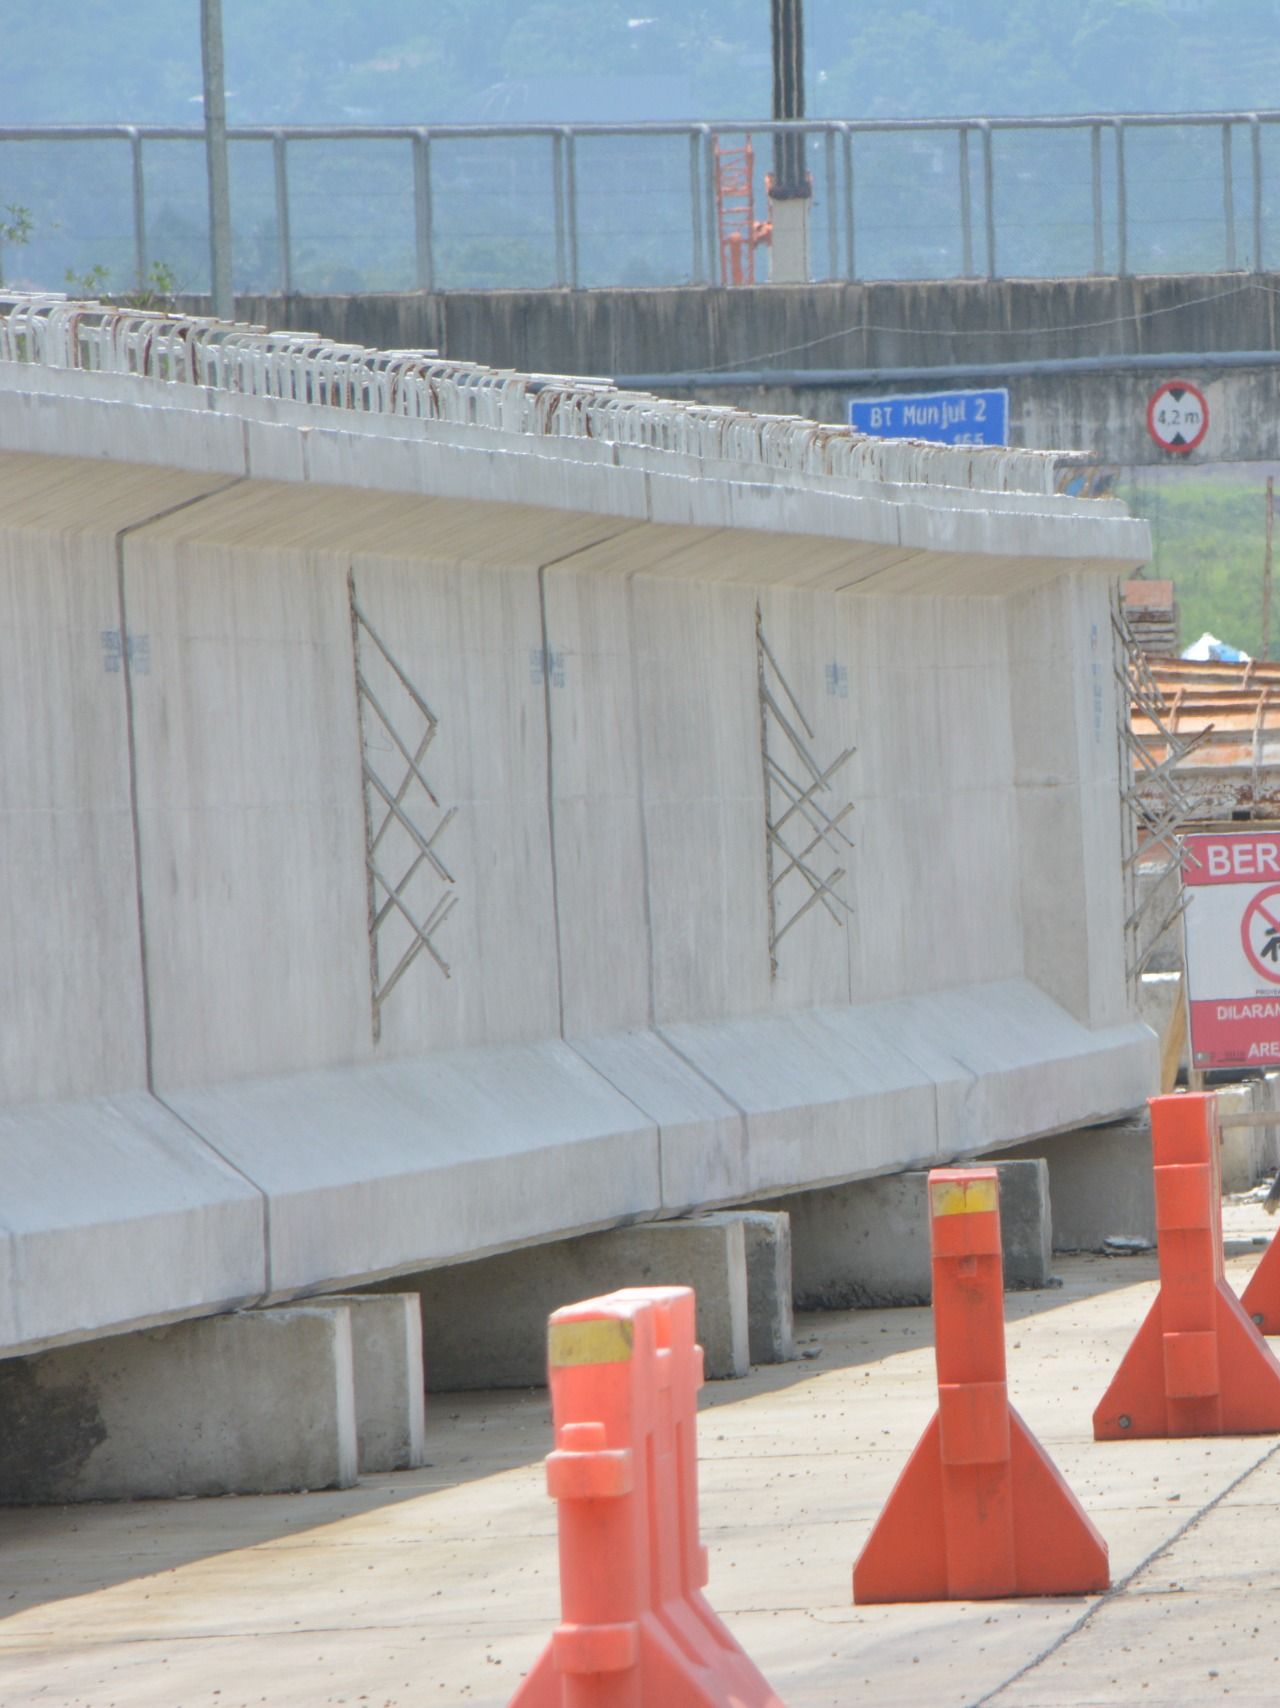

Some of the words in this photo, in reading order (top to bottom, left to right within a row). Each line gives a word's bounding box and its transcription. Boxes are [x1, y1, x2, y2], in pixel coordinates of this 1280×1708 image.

[870, 406, 894, 429] BT
[903, 399, 967, 430] Munjul
[974, 398, 987, 423] 2
[1184, 412, 1200, 425] m
